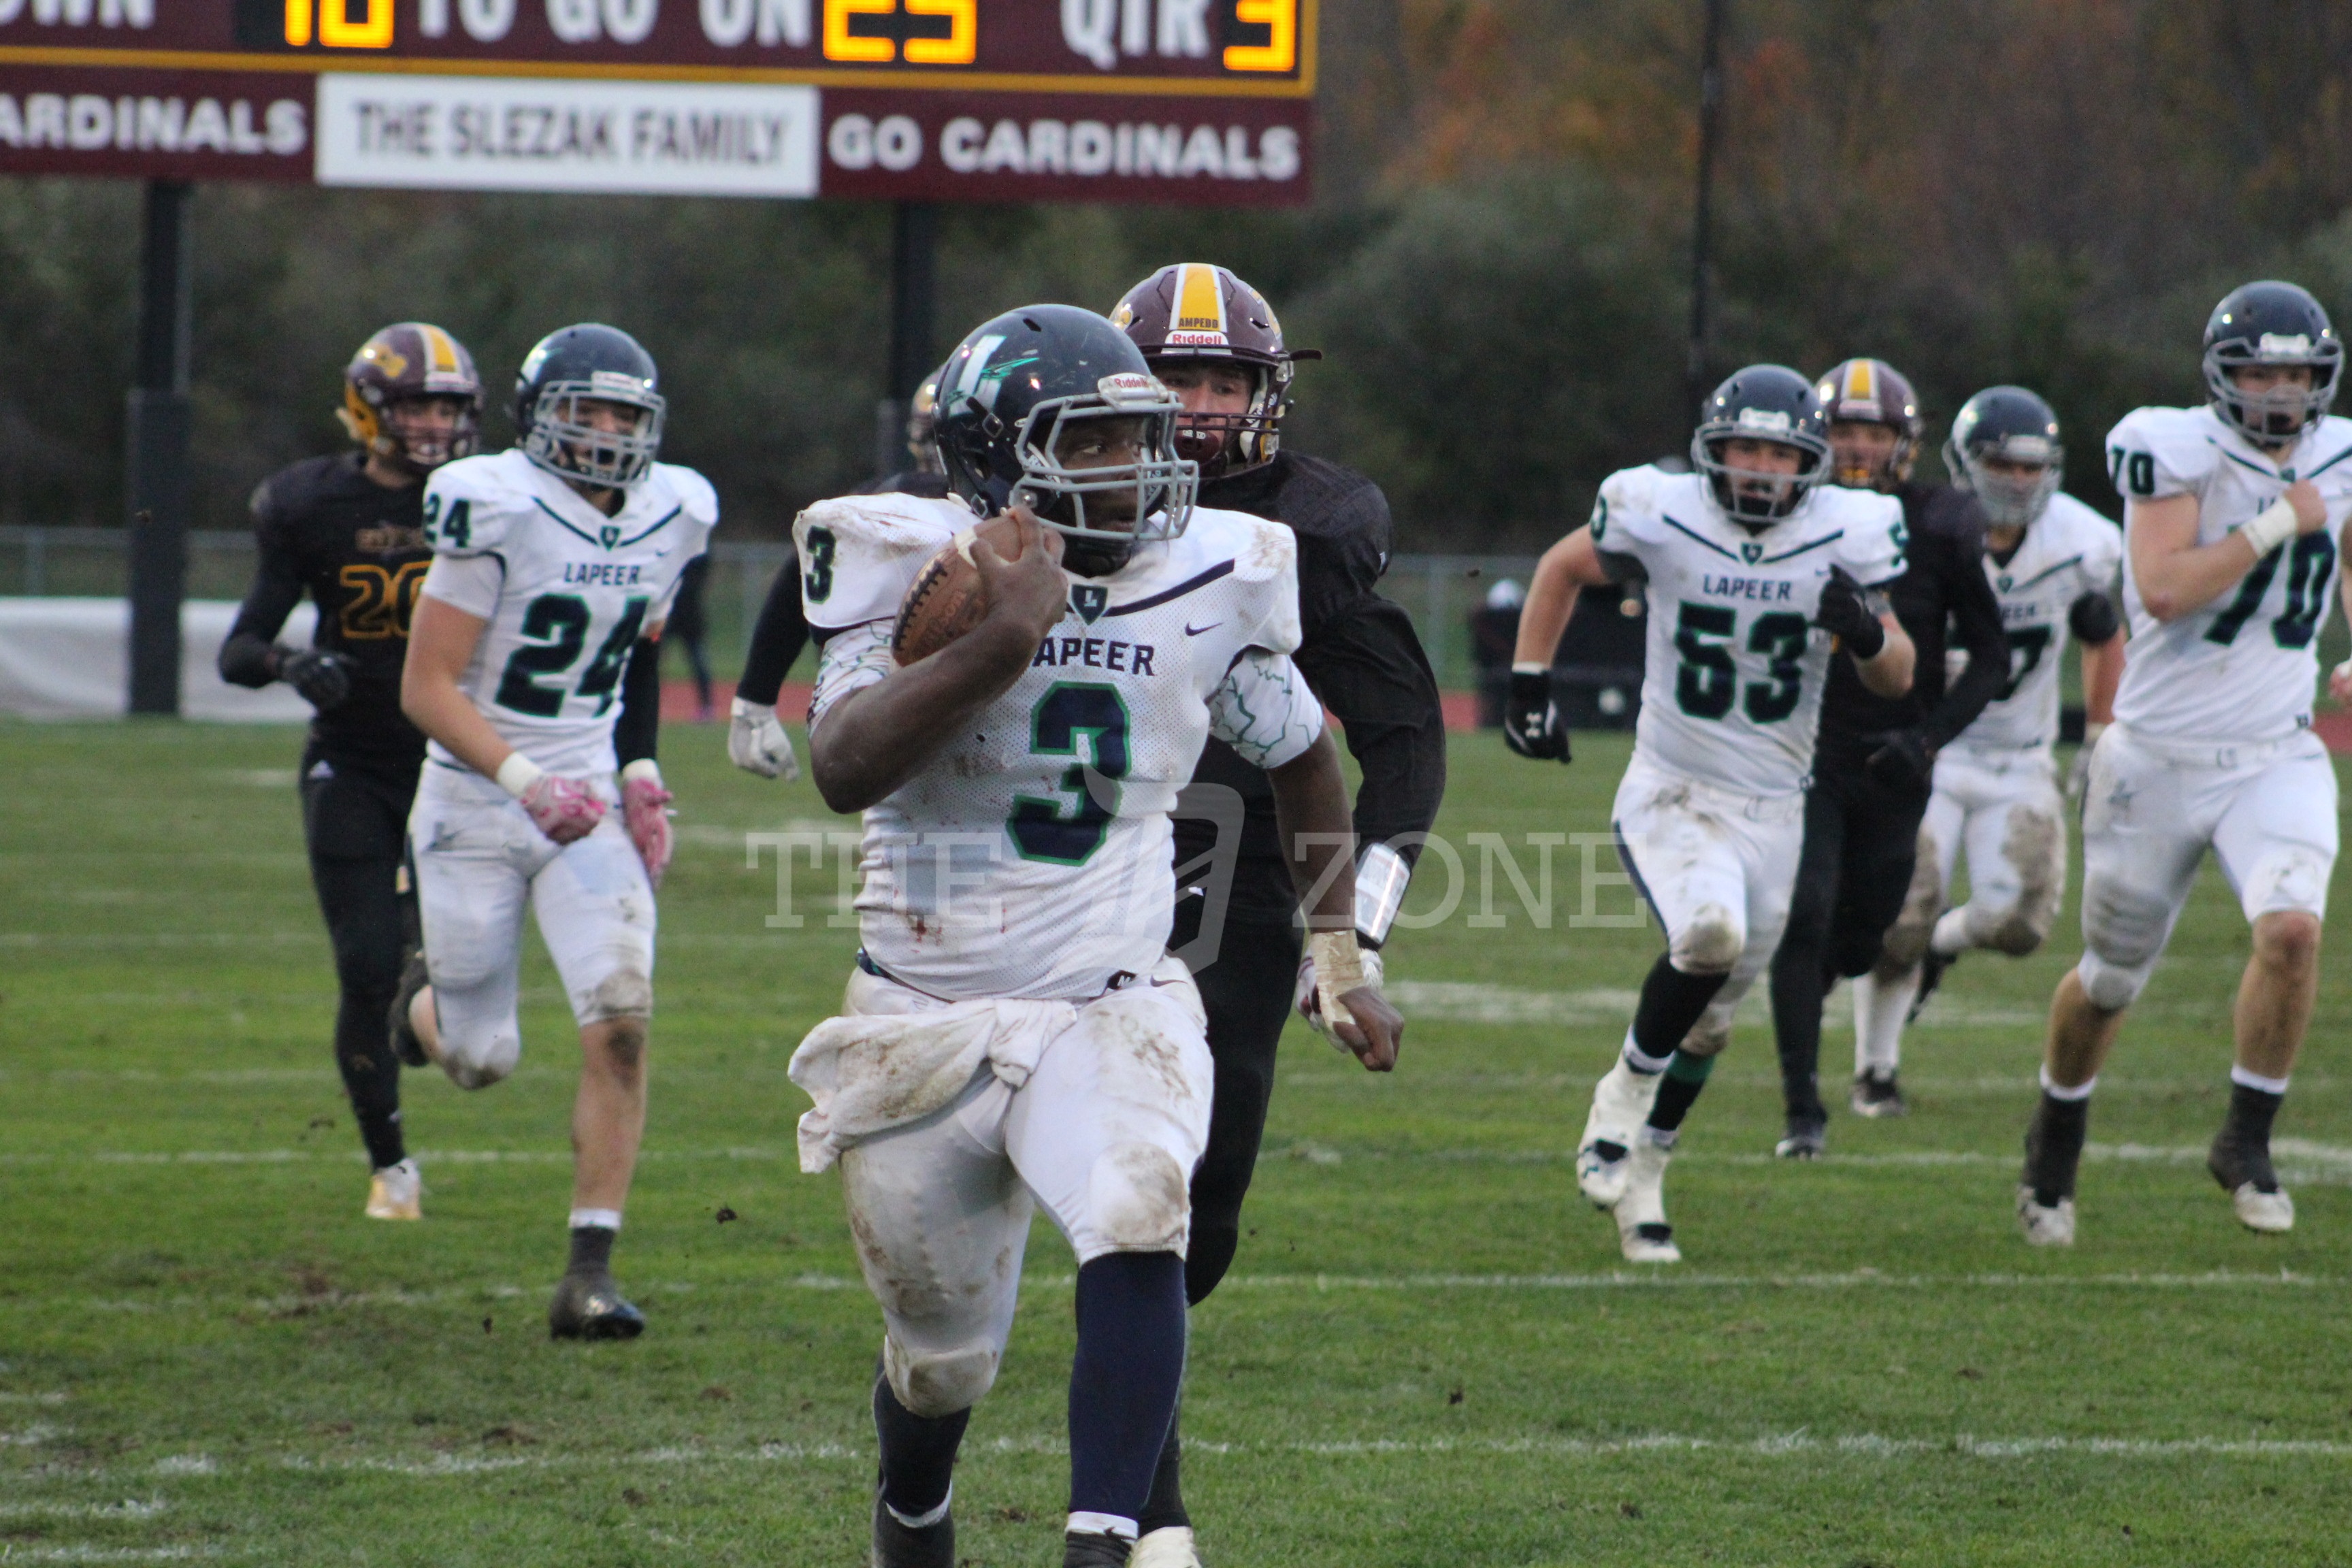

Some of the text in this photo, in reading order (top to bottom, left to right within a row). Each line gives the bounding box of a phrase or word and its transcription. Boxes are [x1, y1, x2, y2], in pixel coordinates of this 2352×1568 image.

[0, 93, 307, 155] ARDINALS
[353, 101, 787, 165] THE SLEZAK FAMILY
[828, 112, 1300, 182] GO CARDINALS
[1172, 333, 1222, 345] Riddell
[2111, 444, 2155, 495] 70
[424, 493, 470, 548] 24
[564, 561, 642, 586] LAPEER
[806, 525, 836, 604] 3
[1703, 573, 1792, 600] LAPEER
[493, 592, 651, 719] 24
[1031, 636, 1156, 676] APEER
[1675, 601, 1810, 724] 53
[1005, 680, 1132, 867] 3
